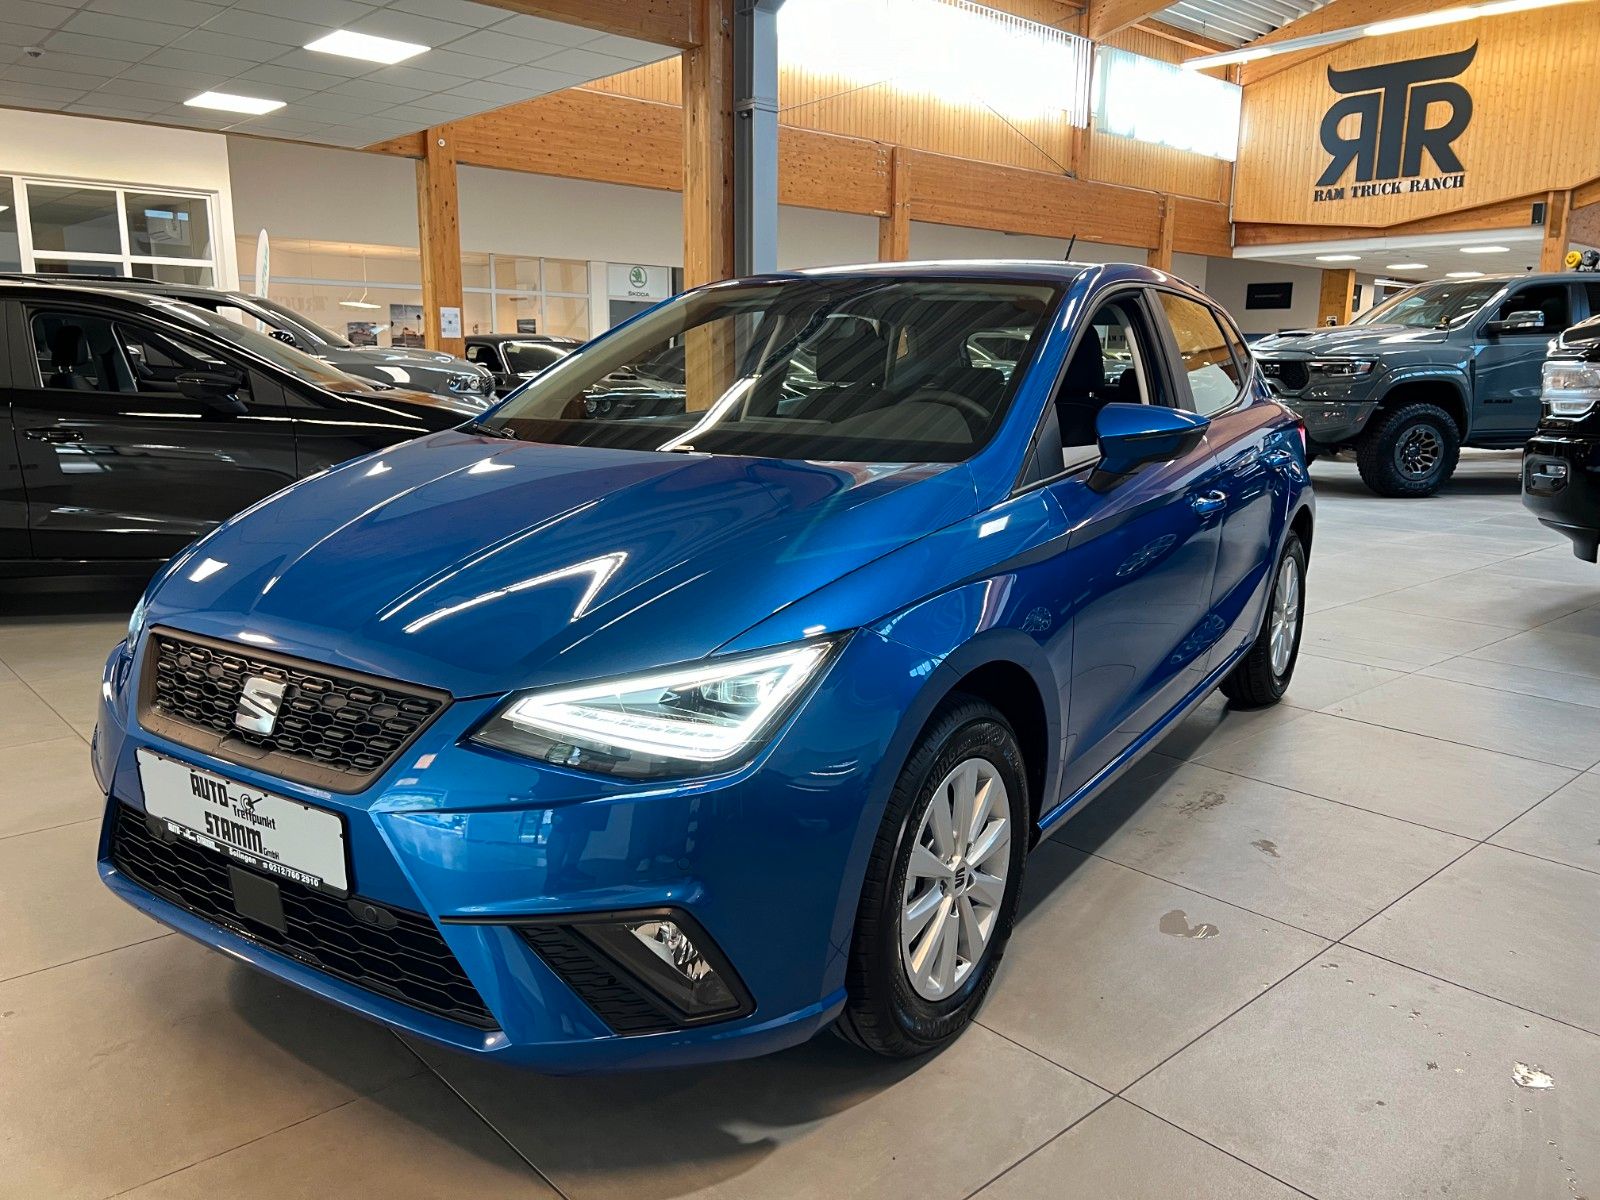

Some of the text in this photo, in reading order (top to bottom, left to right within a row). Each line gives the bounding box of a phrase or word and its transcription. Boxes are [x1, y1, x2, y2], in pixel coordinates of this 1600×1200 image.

[1314, 175, 1465, 202] RAM TRUCK RANCH
[232, 804, 276, 830] Treffpunkt
[204, 811, 263, 854] STAMM
[263, 847, 280, 860] GmbH
[229, 847, 257, 865] Solingen
[301, 874, 319, 887] 2910
